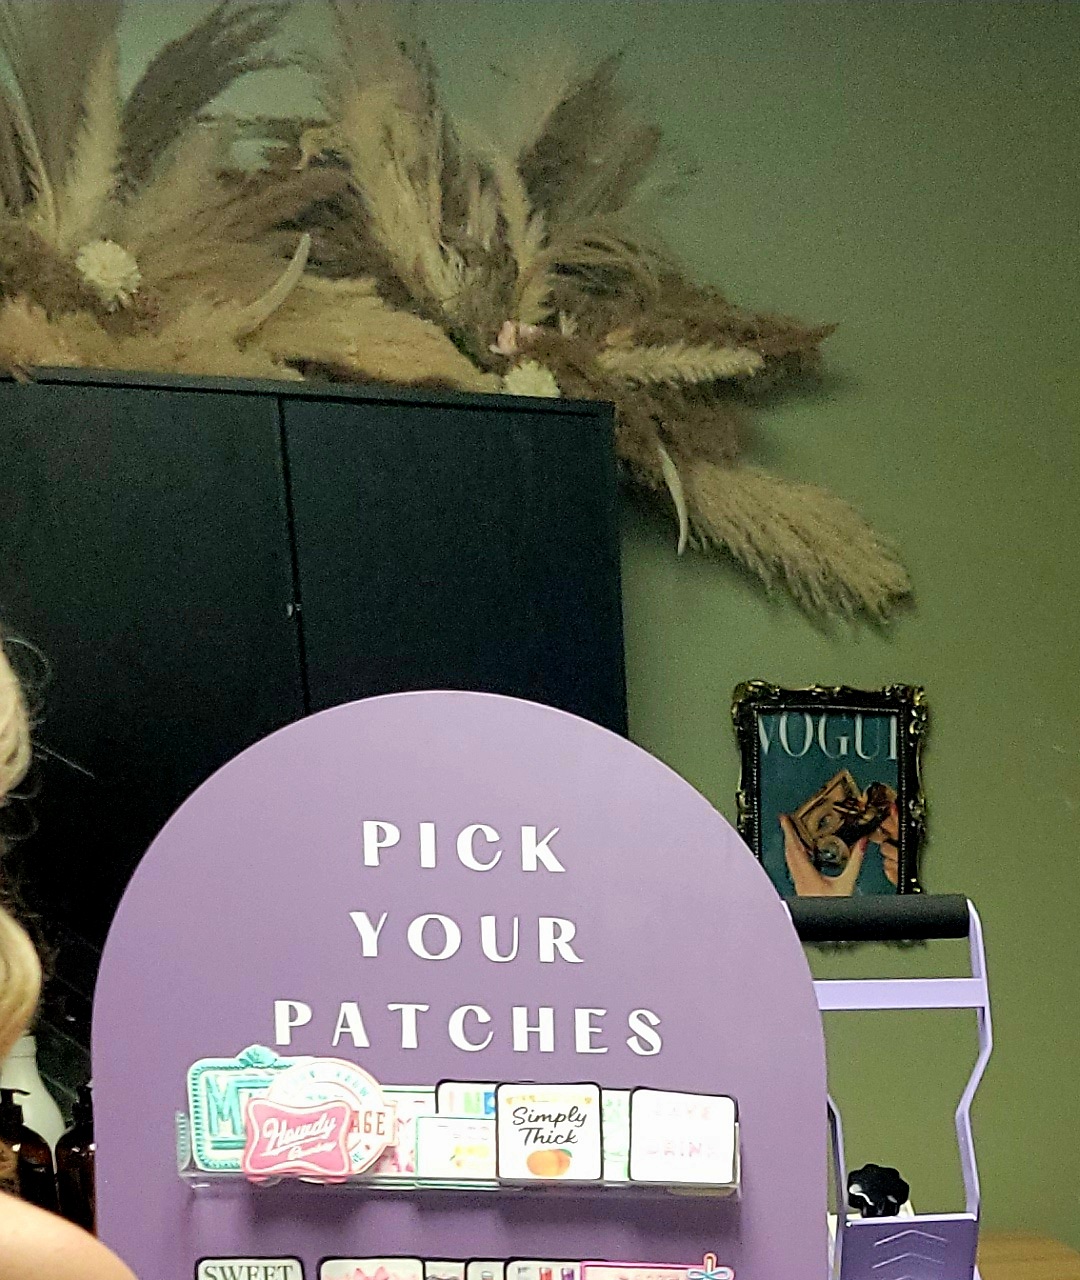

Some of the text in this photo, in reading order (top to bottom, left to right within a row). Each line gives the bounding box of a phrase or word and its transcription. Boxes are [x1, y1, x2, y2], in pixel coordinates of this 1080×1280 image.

[362, 821, 566, 873] PICK
[350, 912, 584, 963] YOUR
[274, 1000, 663, 1056] PATCHES
[512, 1106, 587, 1127] Simply
[518, 1128, 578, 1145] Thick
